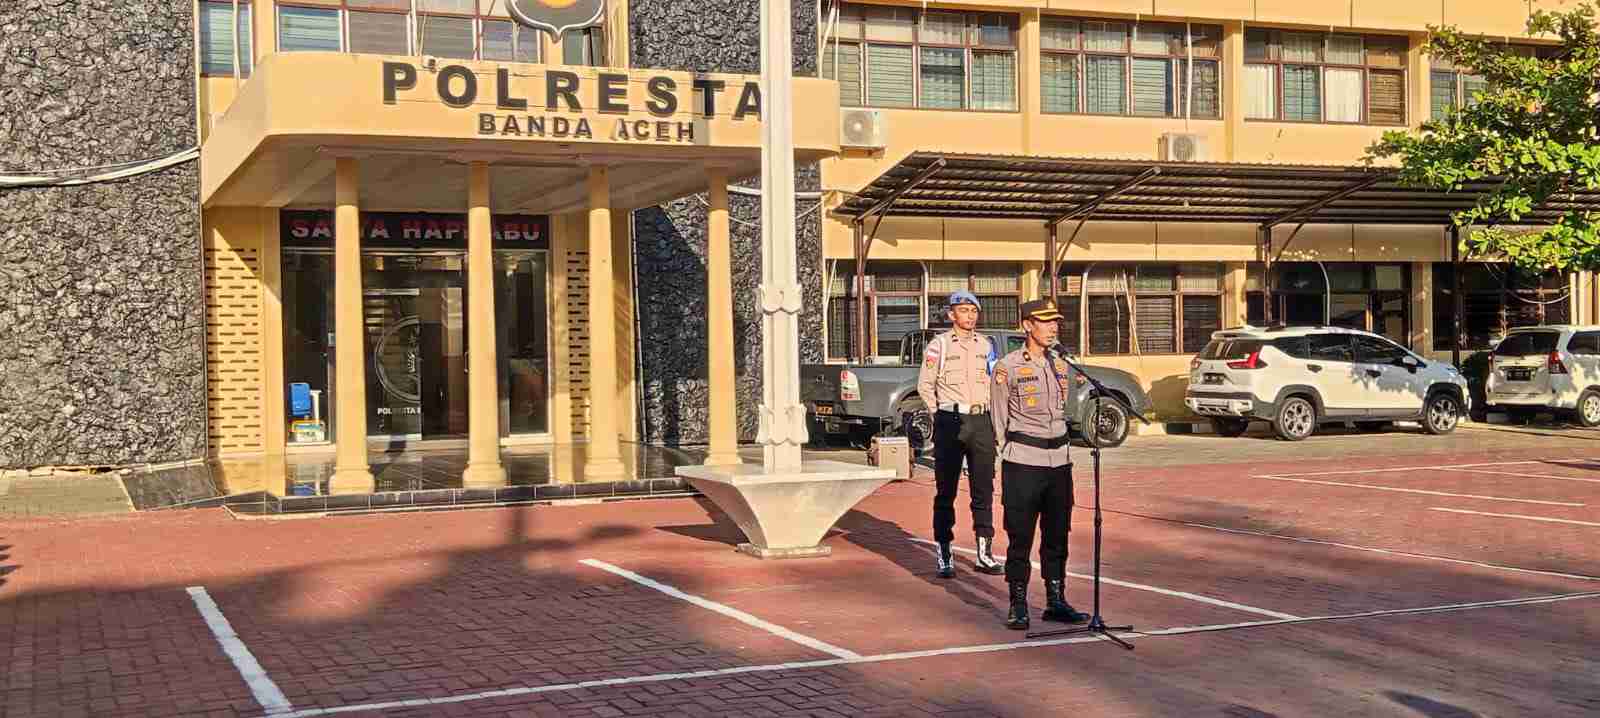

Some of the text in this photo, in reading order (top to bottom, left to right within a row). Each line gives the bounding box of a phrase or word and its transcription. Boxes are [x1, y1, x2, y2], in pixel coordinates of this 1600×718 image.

[382, 61, 762, 121] POLRESTA
[478, 112, 695, 144] BANDA ACEH
[290, 218, 390, 239] SAA
